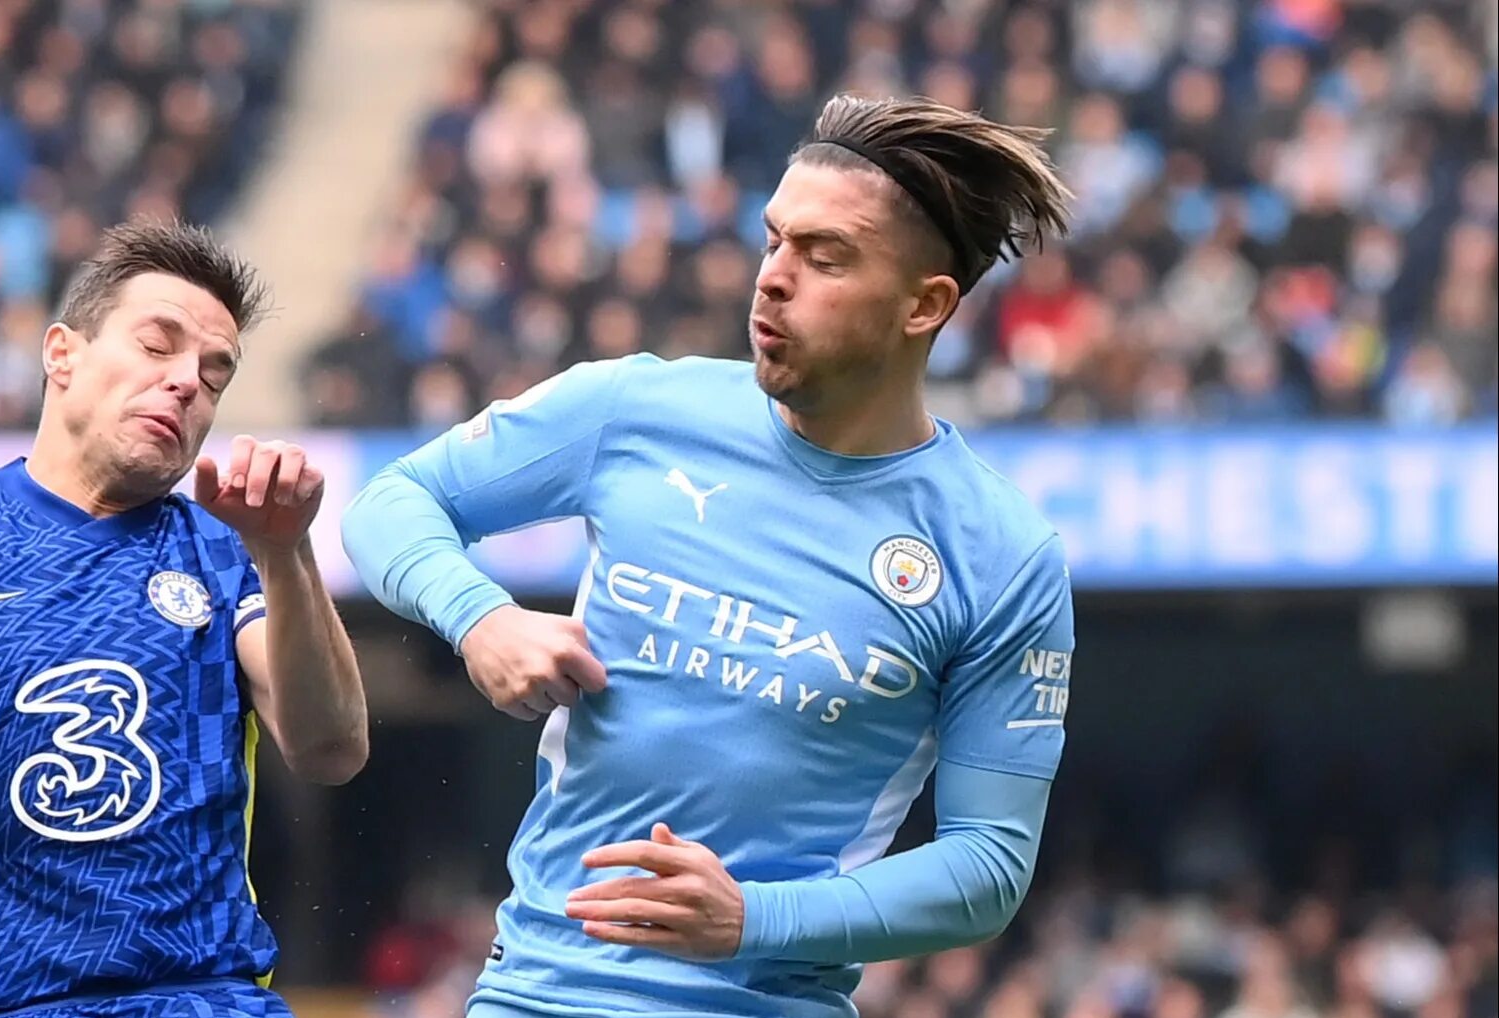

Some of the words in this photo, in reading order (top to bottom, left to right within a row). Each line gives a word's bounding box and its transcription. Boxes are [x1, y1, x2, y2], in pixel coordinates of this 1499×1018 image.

[883, 540, 938, 575] MANCHESTER
[606, 561, 918, 700] ETIHAD
[636, 633, 848, 724] AIRWAYS
[1019, 648, 1072, 679] NEX
[1033, 683, 1069, 715] TIR
[10, 659, 161, 842] 3
